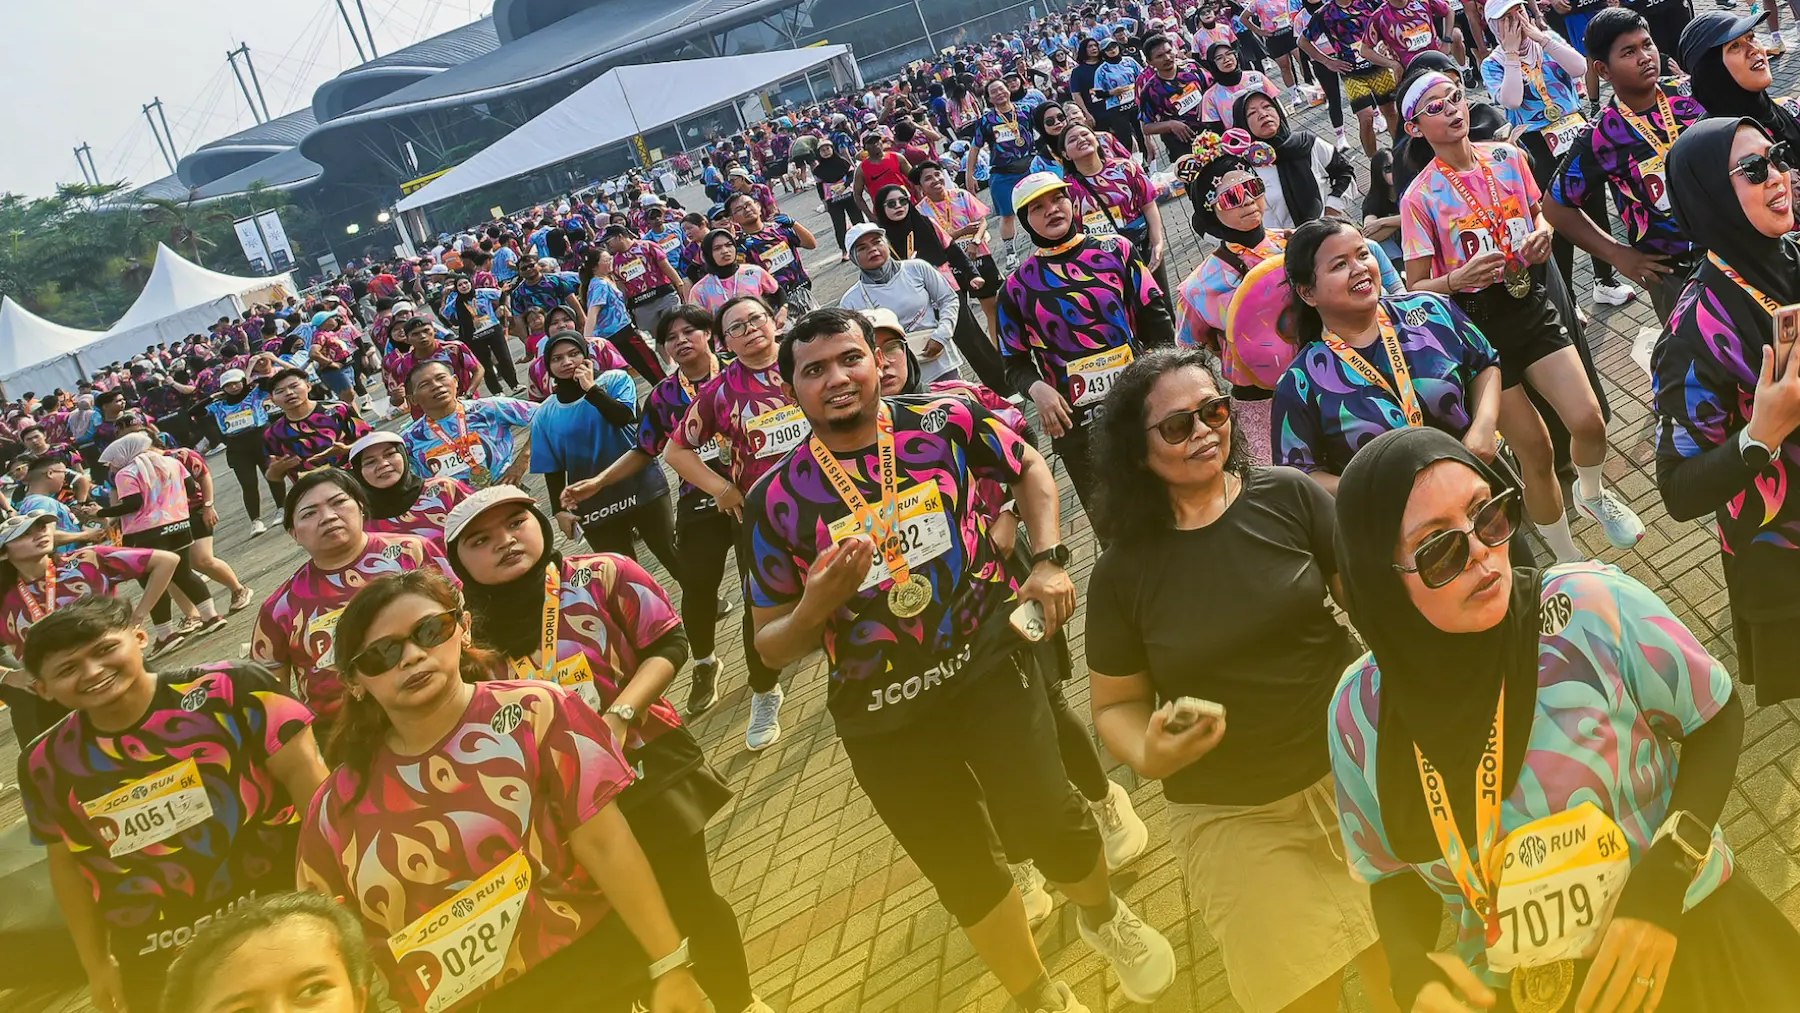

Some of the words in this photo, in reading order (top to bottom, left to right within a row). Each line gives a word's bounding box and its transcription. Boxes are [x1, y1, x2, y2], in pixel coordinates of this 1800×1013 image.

[1635, 121, 1661, 148] JCORUN
[1447, 171, 1477, 207] FINISHER
[1475, 206, 1488, 222] 10K
[1486, 174, 1500, 208] JCORUN
[1651, 183, 1658, 198] F
[1467, 239, 1474, 255] F
[1079, 362, 1094, 371] JCO
[1349, 355, 1382, 386] JCORUN
[1388, 335, 1405, 375] JCORUN
[1073, 382, 1080, 395] F
[754, 436, 761, 449] F
[767, 424, 801, 447] 7908
[759, 418, 774, 426] JCO
[814, 445, 851, 497] FINISHER
[850, 496, 864, 512] 5K
[884, 445, 893, 491] JCORUN
[582, 494, 637, 525] JCORUN
[924, 497, 939, 513] 5K
[545, 607, 556, 650] JCORUN
[316, 639, 325, 655] F
[574, 668, 589, 681] 5K
[104, 796, 129, 811] JCO
[150, 775, 174, 791] RUN
[180, 775, 196, 789] 5K
[99, 827, 117, 842] M
[123, 802, 177, 838] 4051
[1551, 825, 1586, 853] RUN
[1597, 829, 1621, 858] 5K
[417, 914, 450, 944] JCO
[476, 876, 506, 902] RUN
[514, 870, 529, 892] 5K
[1498, 883, 1593, 954] 7079
[415, 964, 430, 991] F
